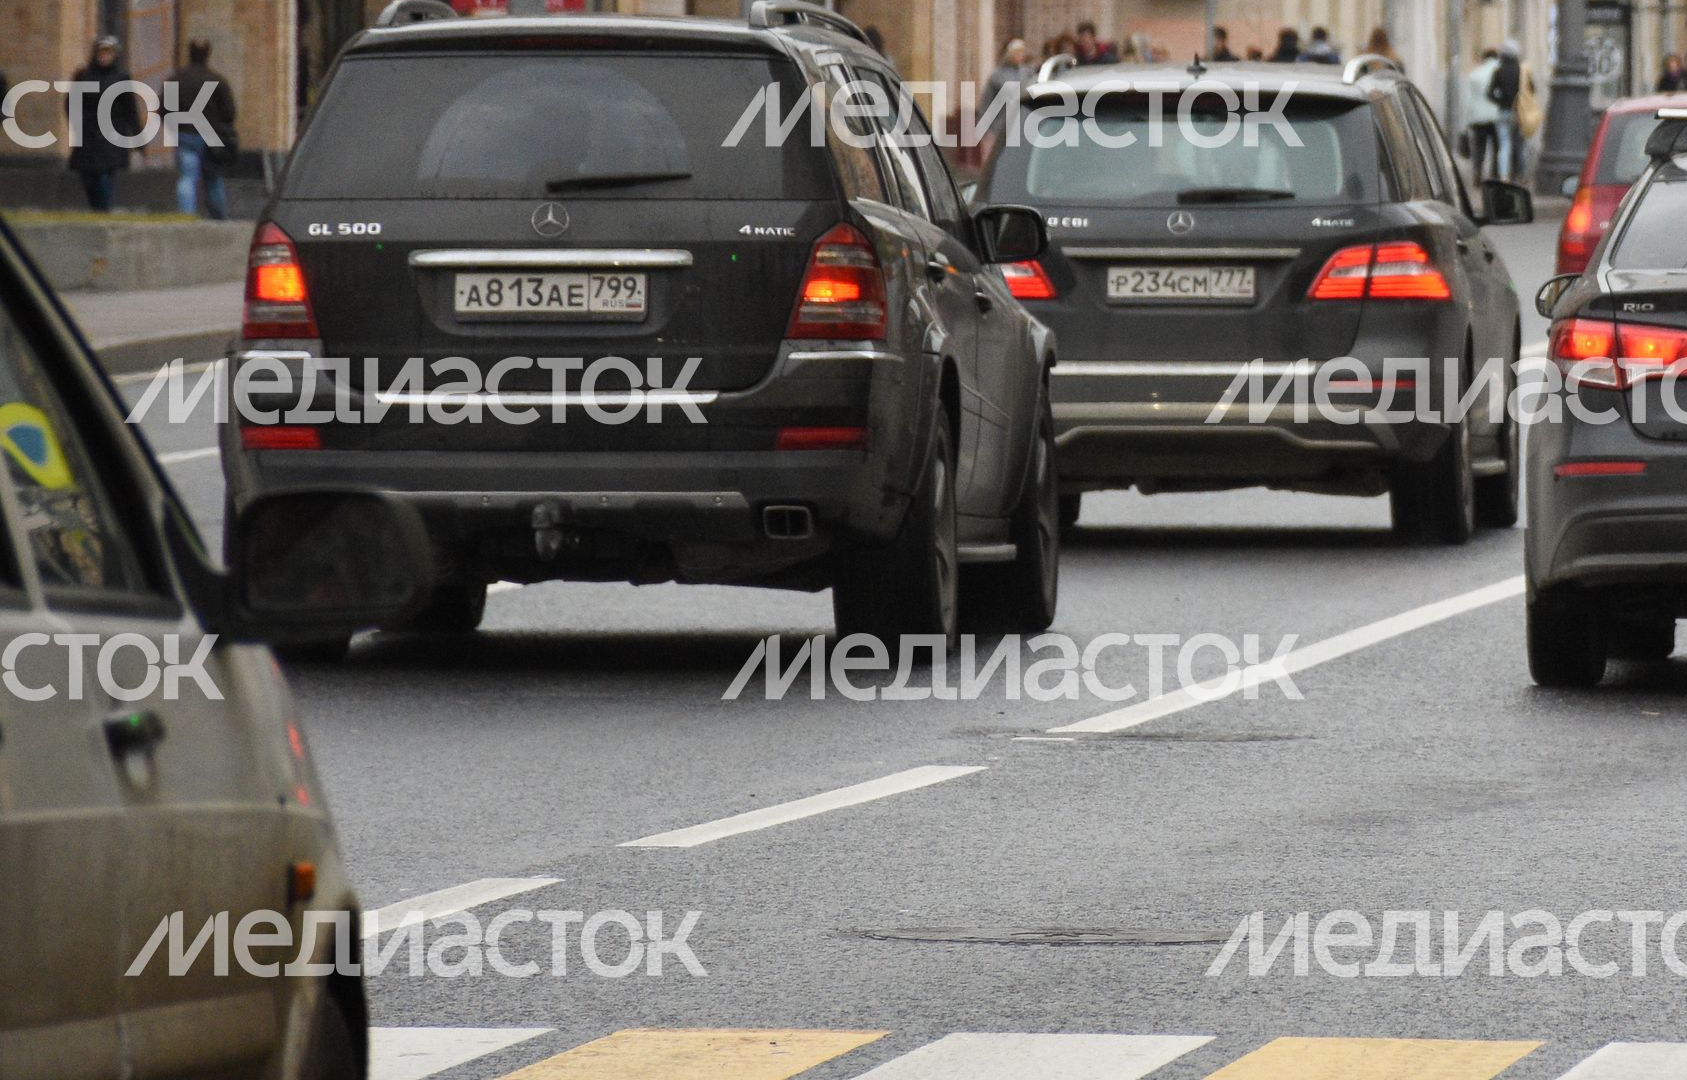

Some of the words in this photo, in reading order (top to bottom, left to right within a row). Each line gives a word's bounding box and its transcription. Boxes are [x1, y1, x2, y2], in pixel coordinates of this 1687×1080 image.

[308, 223, 333, 236] GL
[338, 222, 381, 236] 500
[1214, 270, 1247, 286] 777
[592, 276, 637, 298] 799
[1623, 303, 1655, 312] RIO
